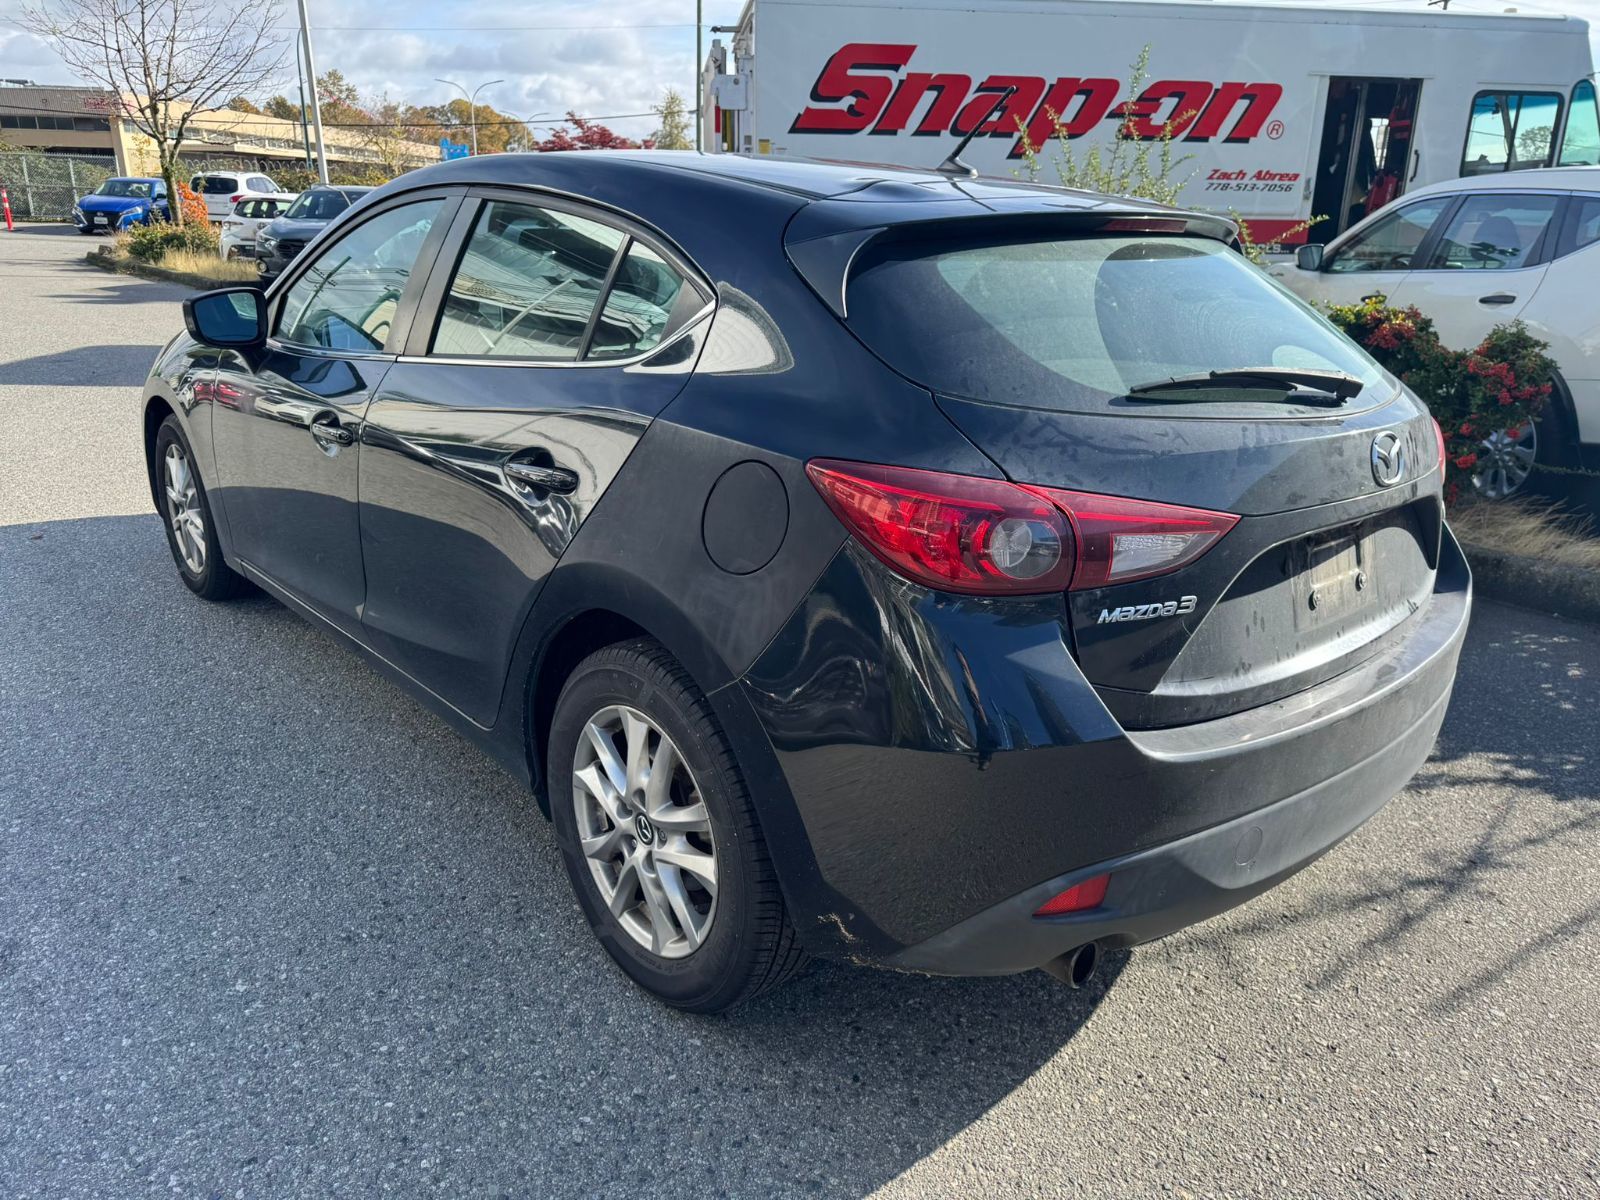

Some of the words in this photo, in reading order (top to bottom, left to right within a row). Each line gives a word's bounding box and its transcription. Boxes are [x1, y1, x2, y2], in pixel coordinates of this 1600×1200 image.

[788, 42, 1283, 160] Snap-on
[1207, 168, 1247, 181] Zach
[1250, 169, 1301, 182] Abrea
[1204, 181, 1294, 193] 778-513-7056
